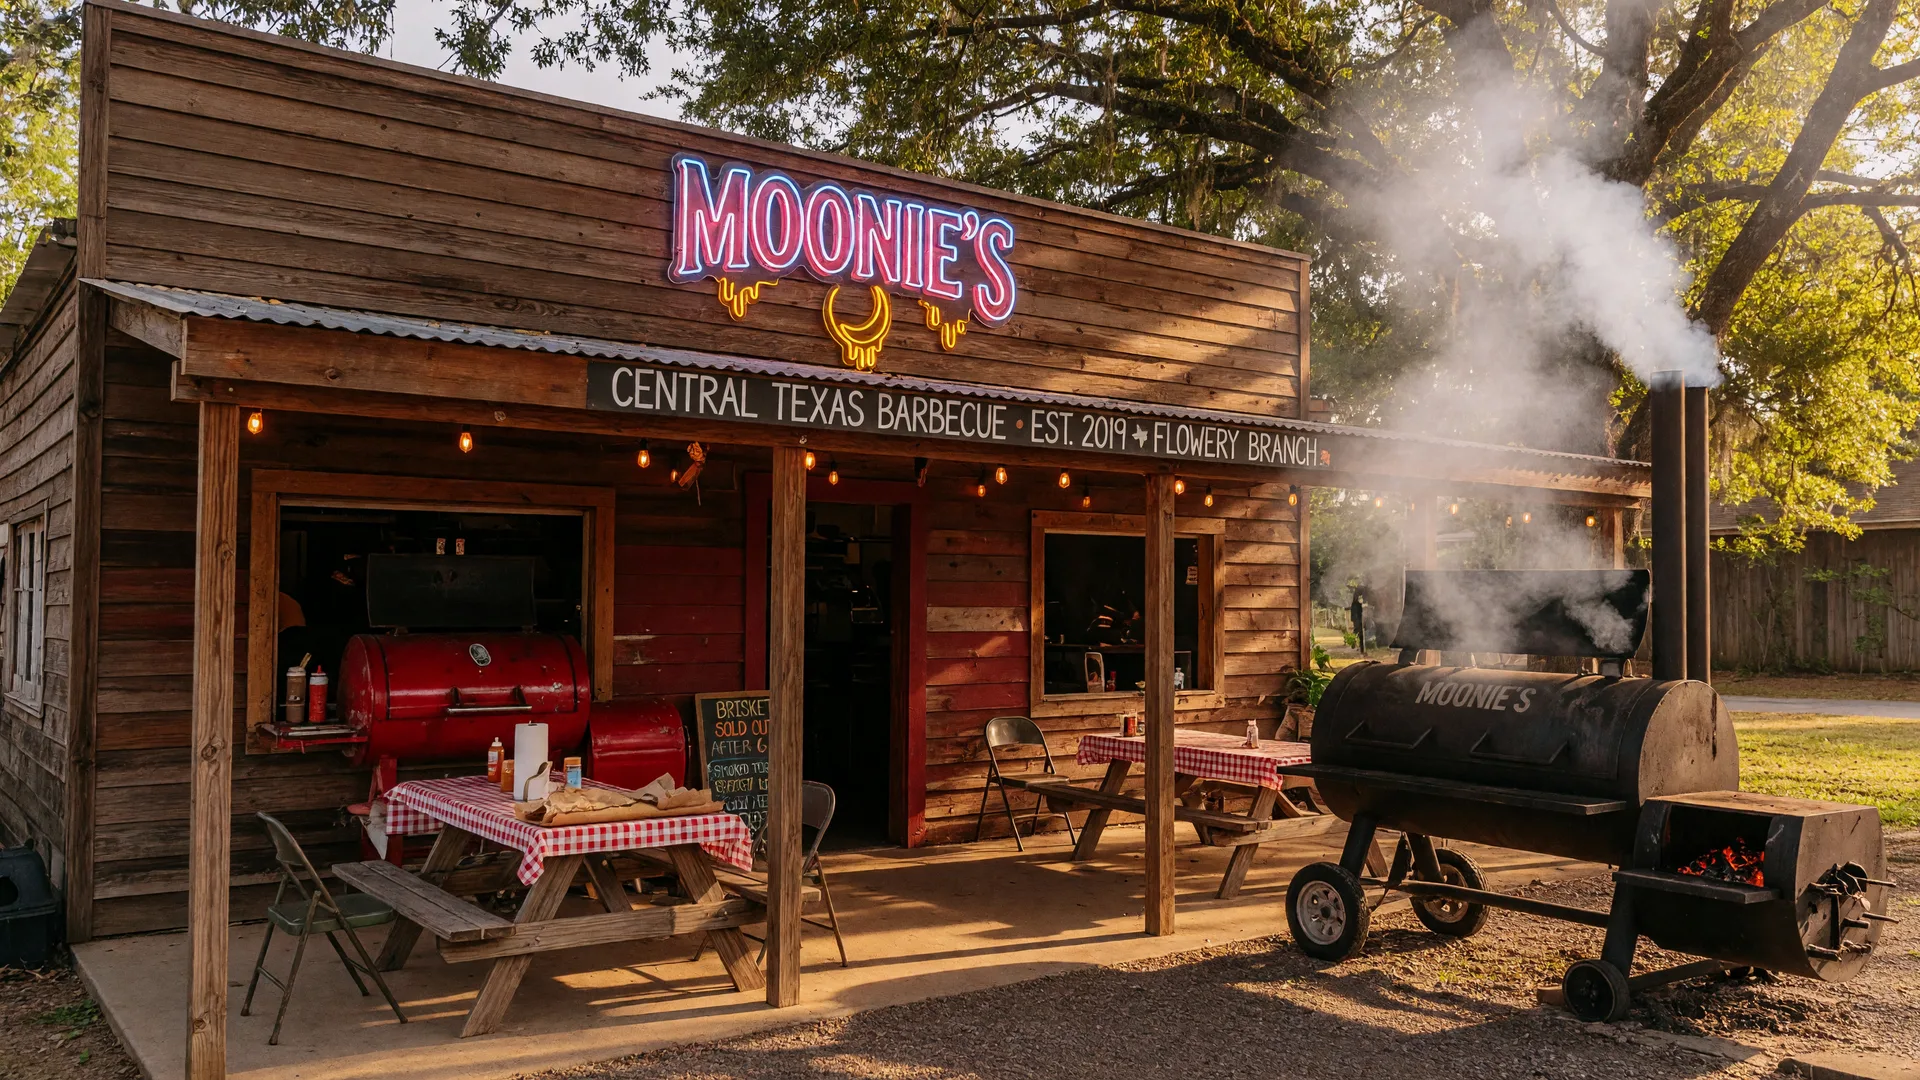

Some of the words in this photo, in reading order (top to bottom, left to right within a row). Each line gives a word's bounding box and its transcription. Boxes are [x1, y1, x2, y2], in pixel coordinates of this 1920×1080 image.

[675, 158, 1017, 322] MOONIE'S
[611, 366, 758, 419] CENTRAL
[771, 382, 865, 427] TEXAS
[877, 392, 1007, 440] BARBECUE
[1030, 409, 1073, 445] EST.
[1081, 414, 1127, 449] 2019
[1153, 422, 1240, 459] FLOWERY
[1248, 432, 1317, 466] BRANCH
[1415, 681, 1536, 713] MOONIE'S
[715, 721, 747, 737] SOLD
[711, 740, 752, 756] AFTER
